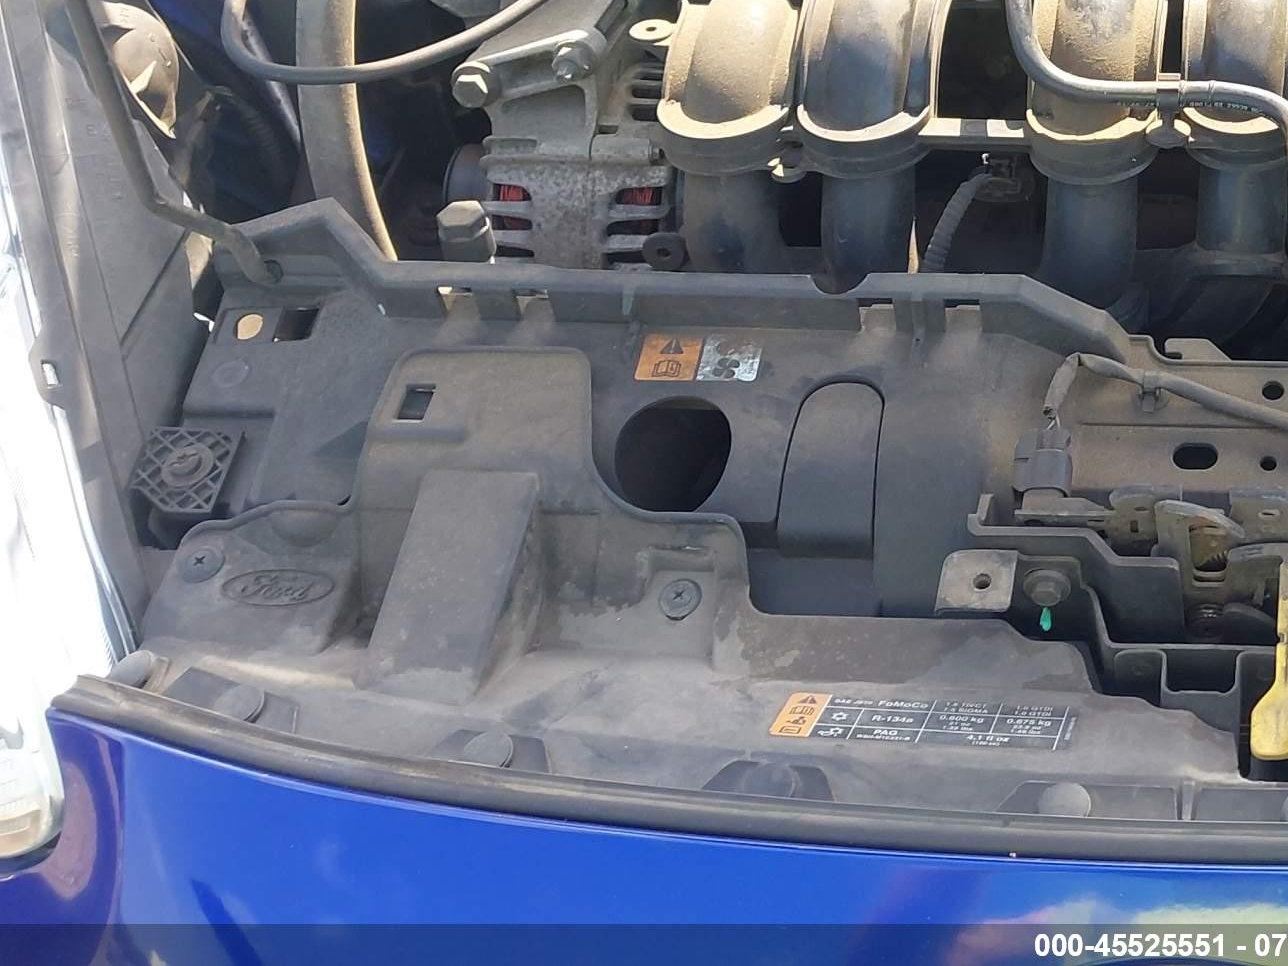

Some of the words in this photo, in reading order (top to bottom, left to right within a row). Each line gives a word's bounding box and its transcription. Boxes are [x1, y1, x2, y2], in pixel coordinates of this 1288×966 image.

[241, 574, 314, 602] Ford
[878, 700, 929, 709] FoMoCo
[871, 714, 915, 723] R-134a
[969, 716, 985, 724] kg
[1037, 719, 1052, 727] kg
